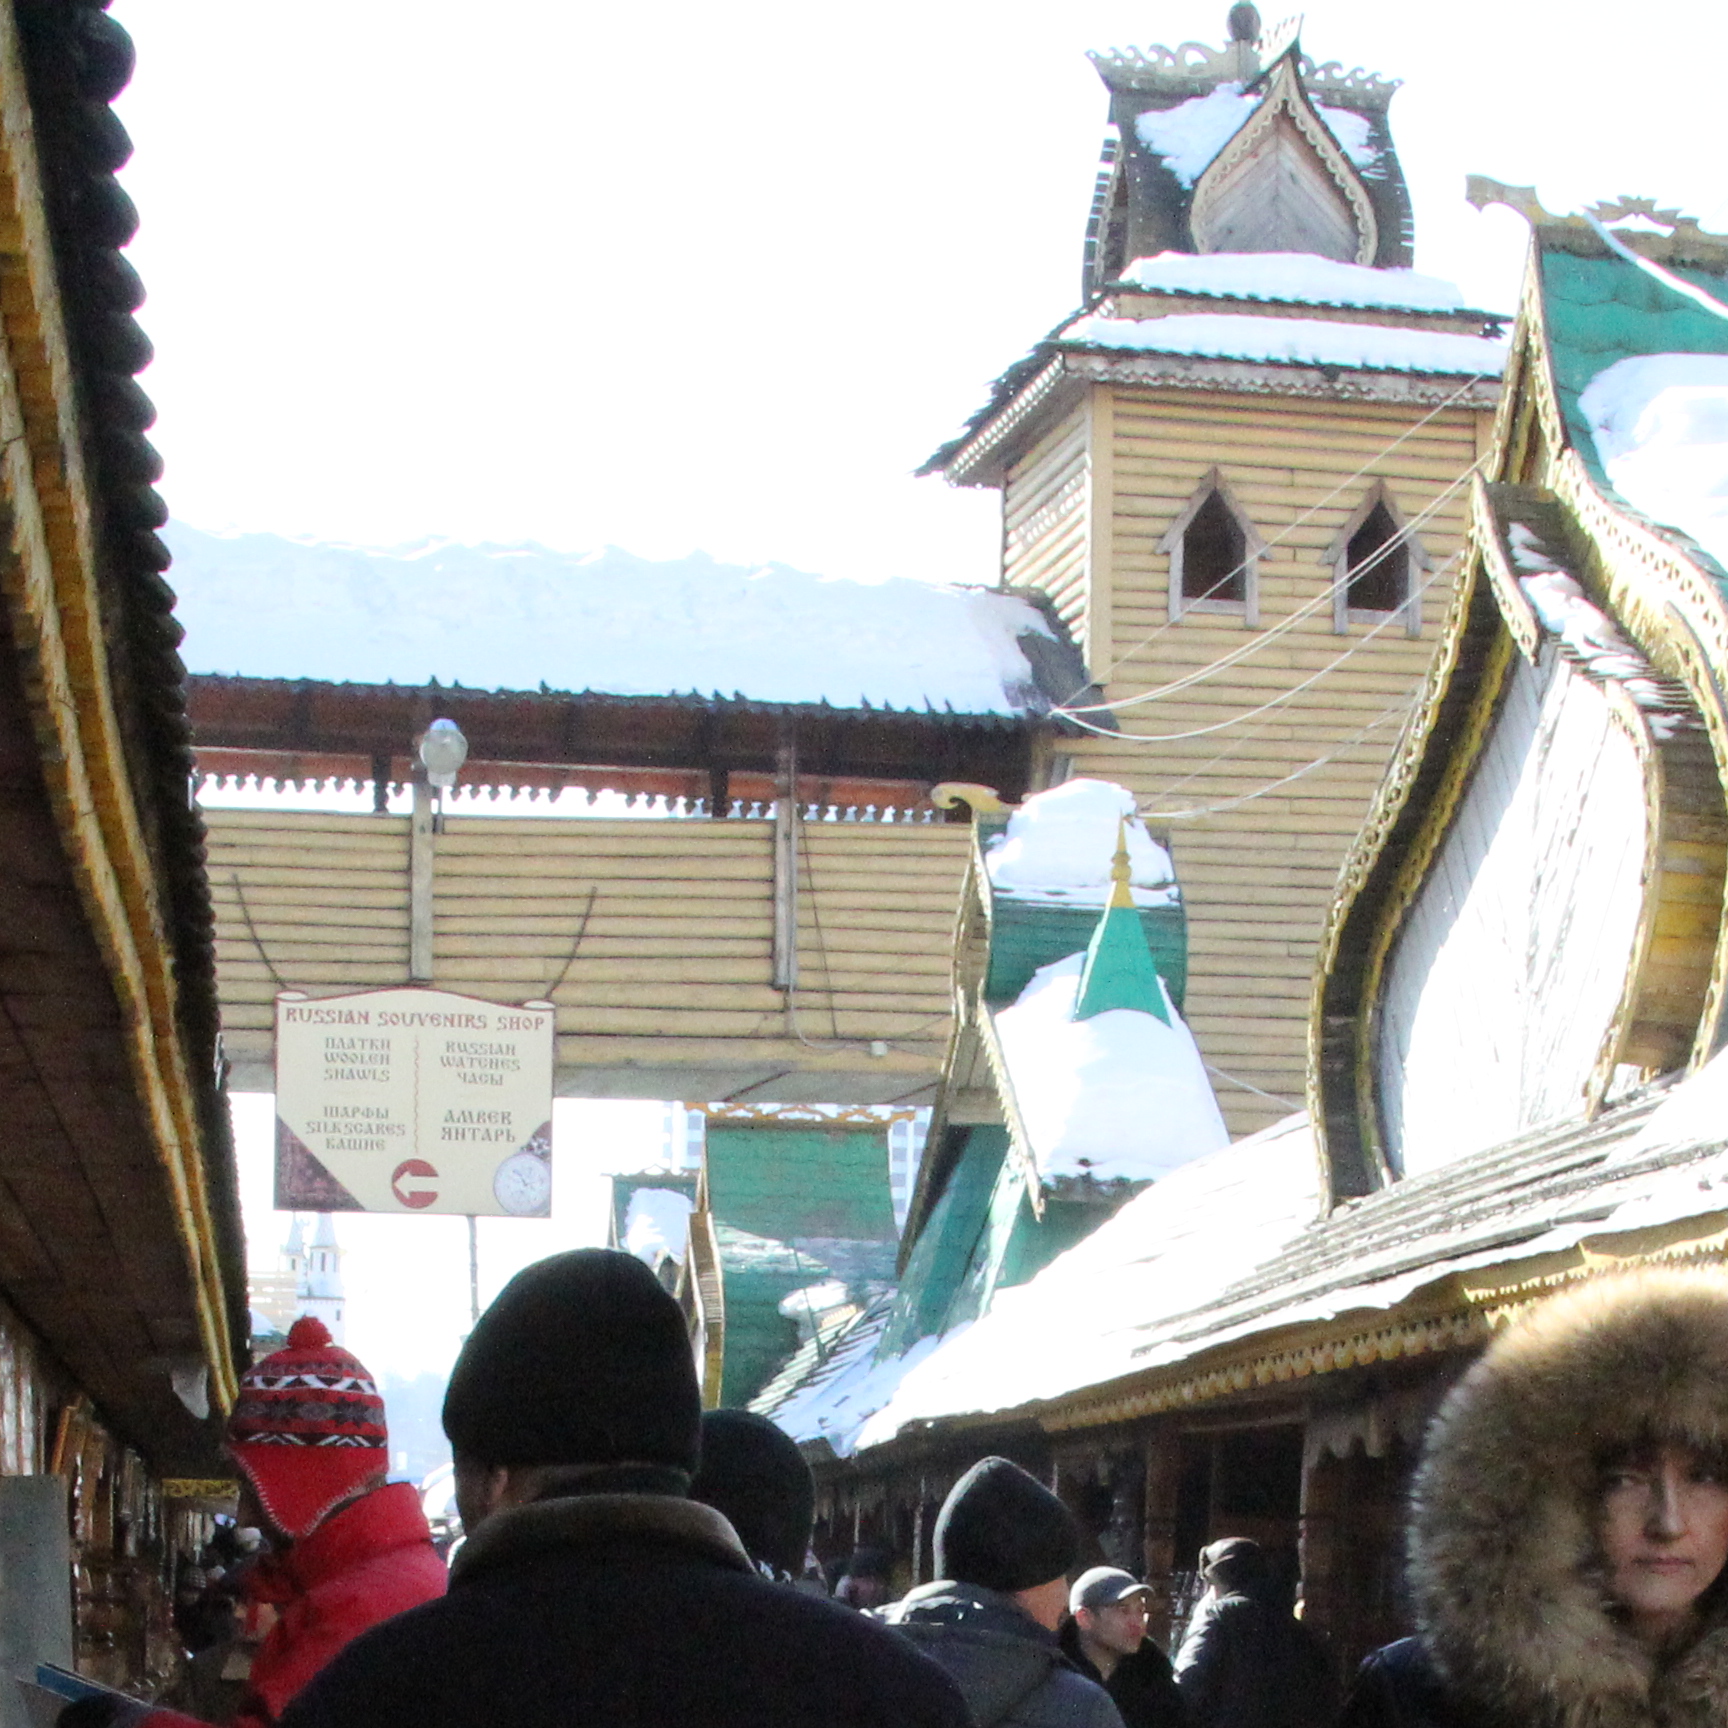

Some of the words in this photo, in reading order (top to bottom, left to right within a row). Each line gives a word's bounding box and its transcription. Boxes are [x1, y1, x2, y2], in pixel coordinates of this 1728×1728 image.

[285, 1007, 370, 1025] RUSSIAN
[377, 1010, 488, 1030] SOUVENIRS
[496, 1015, 545, 1031] SHOP
[324, 1036, 391, 1051] ПЛАТКИ
[445, 1040, 517, 1056] RUSSIAN
[324, 1051, 391, 1066] WOOLEN
[439, 1055, 522, 1072] WATCHES
[323, 1068, 391, 1083] SHAWLS
[456, 1072, 504, 1087] ЧАСЫ
[323, 1105, 390, 1120] ШАРФЫ
[443, 1108, 513, 1126] AMBER
[440, 1126, 517, 1144] ЯНТАРЬ
